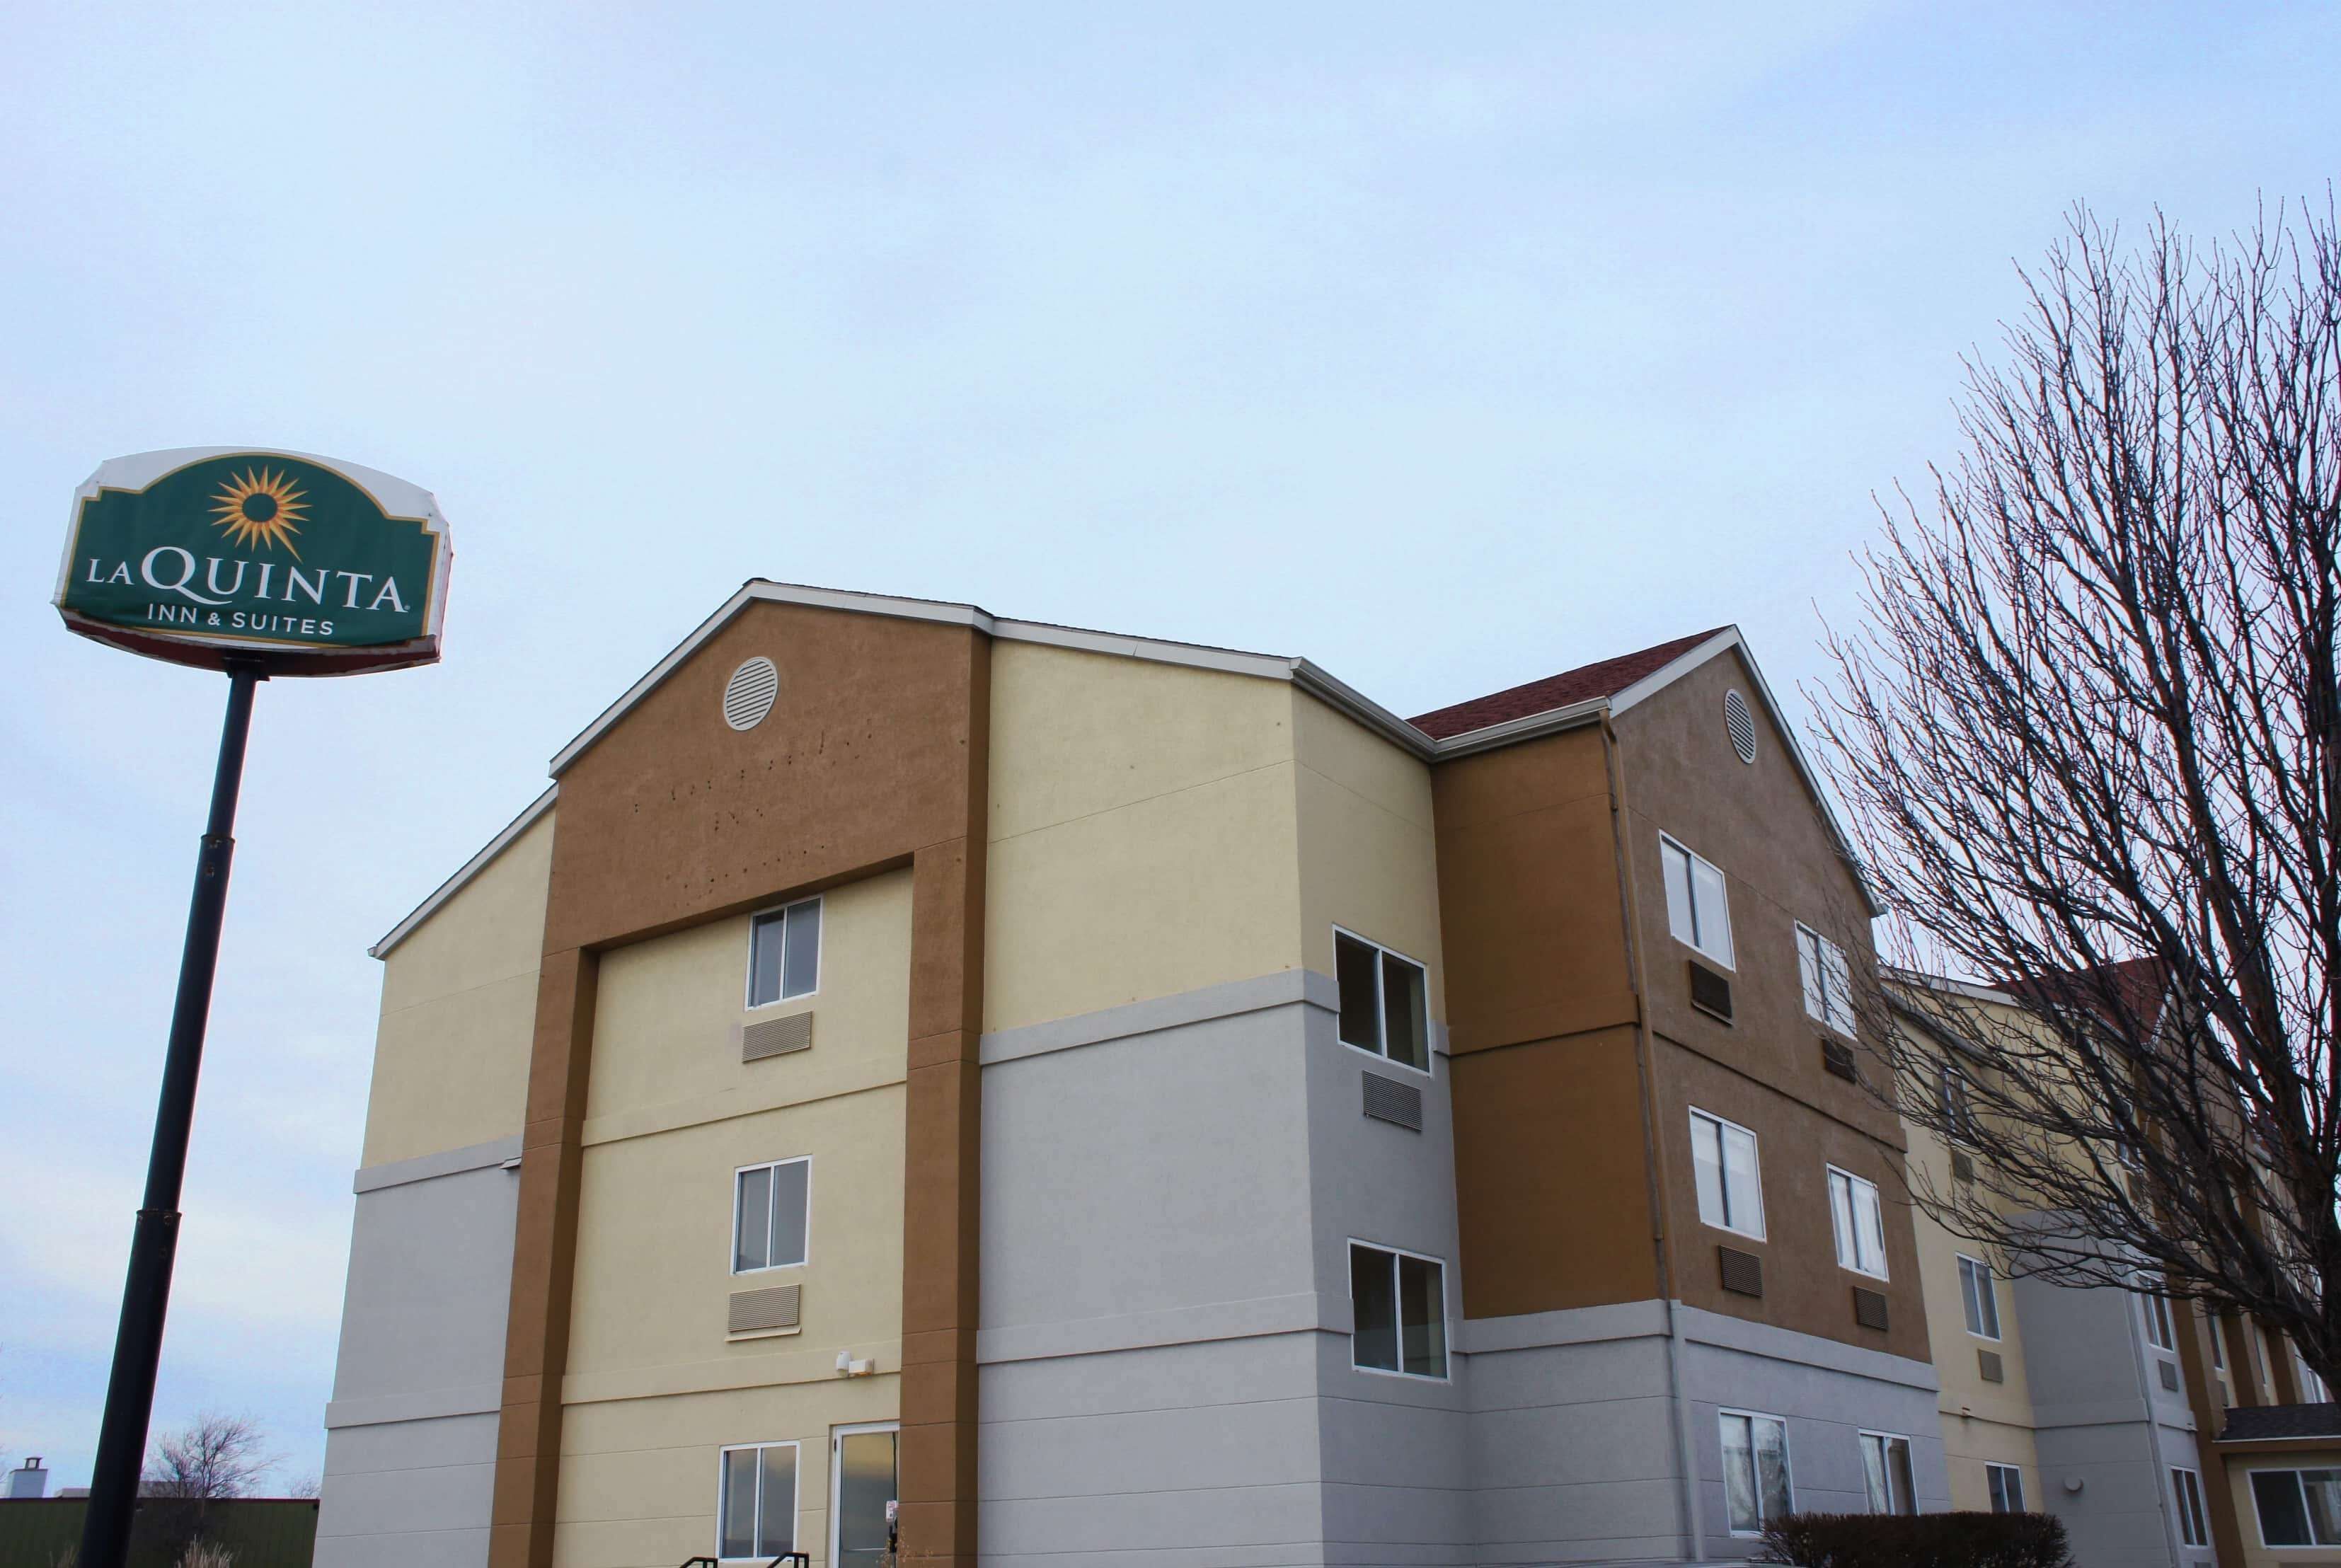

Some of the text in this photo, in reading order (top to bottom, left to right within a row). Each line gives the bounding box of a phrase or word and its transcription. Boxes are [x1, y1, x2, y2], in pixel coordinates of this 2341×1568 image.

[86, 546, 409, 613] LA QUINTA
[147, 604, 334, 635] INN & SUITES
